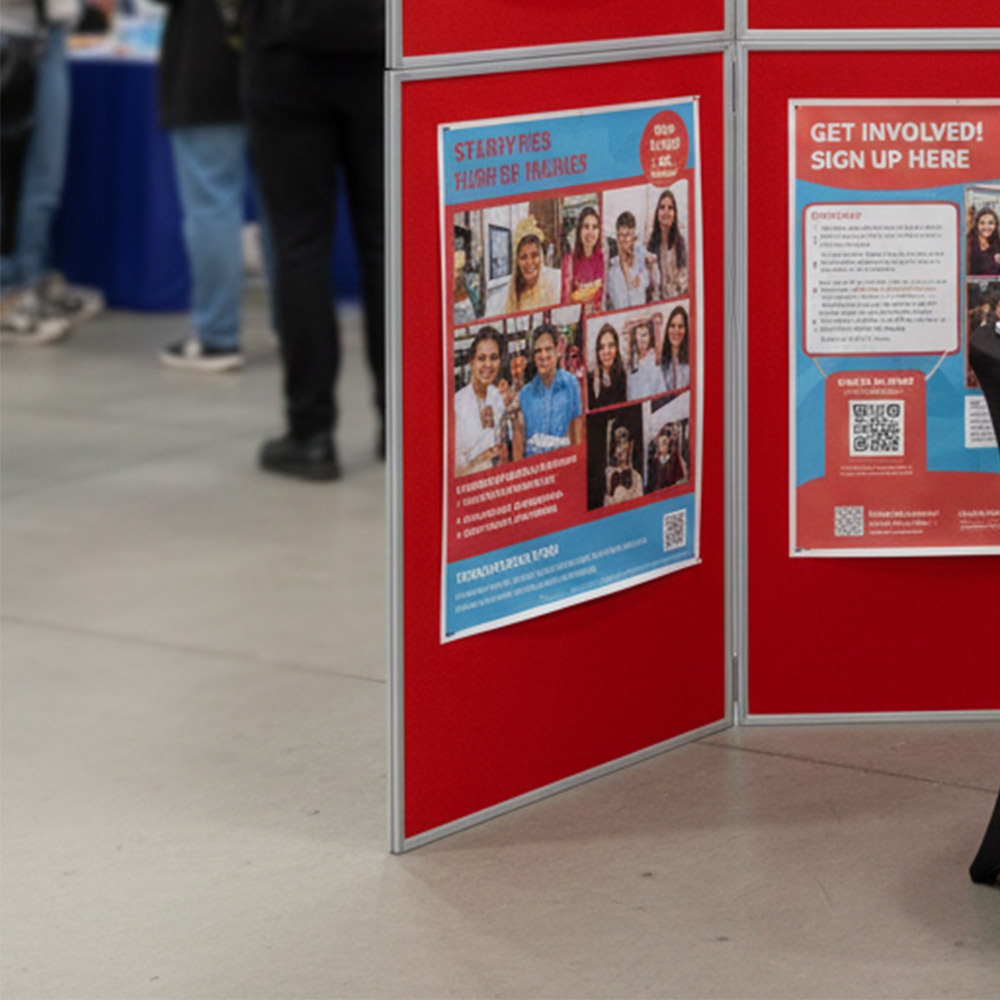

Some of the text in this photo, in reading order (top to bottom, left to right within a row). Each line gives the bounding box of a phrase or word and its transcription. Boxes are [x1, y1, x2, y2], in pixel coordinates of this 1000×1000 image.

[810, 121, 983, 142] GET INVOLVED!
[811, 149, 970, 170] SIGN UP HERE
